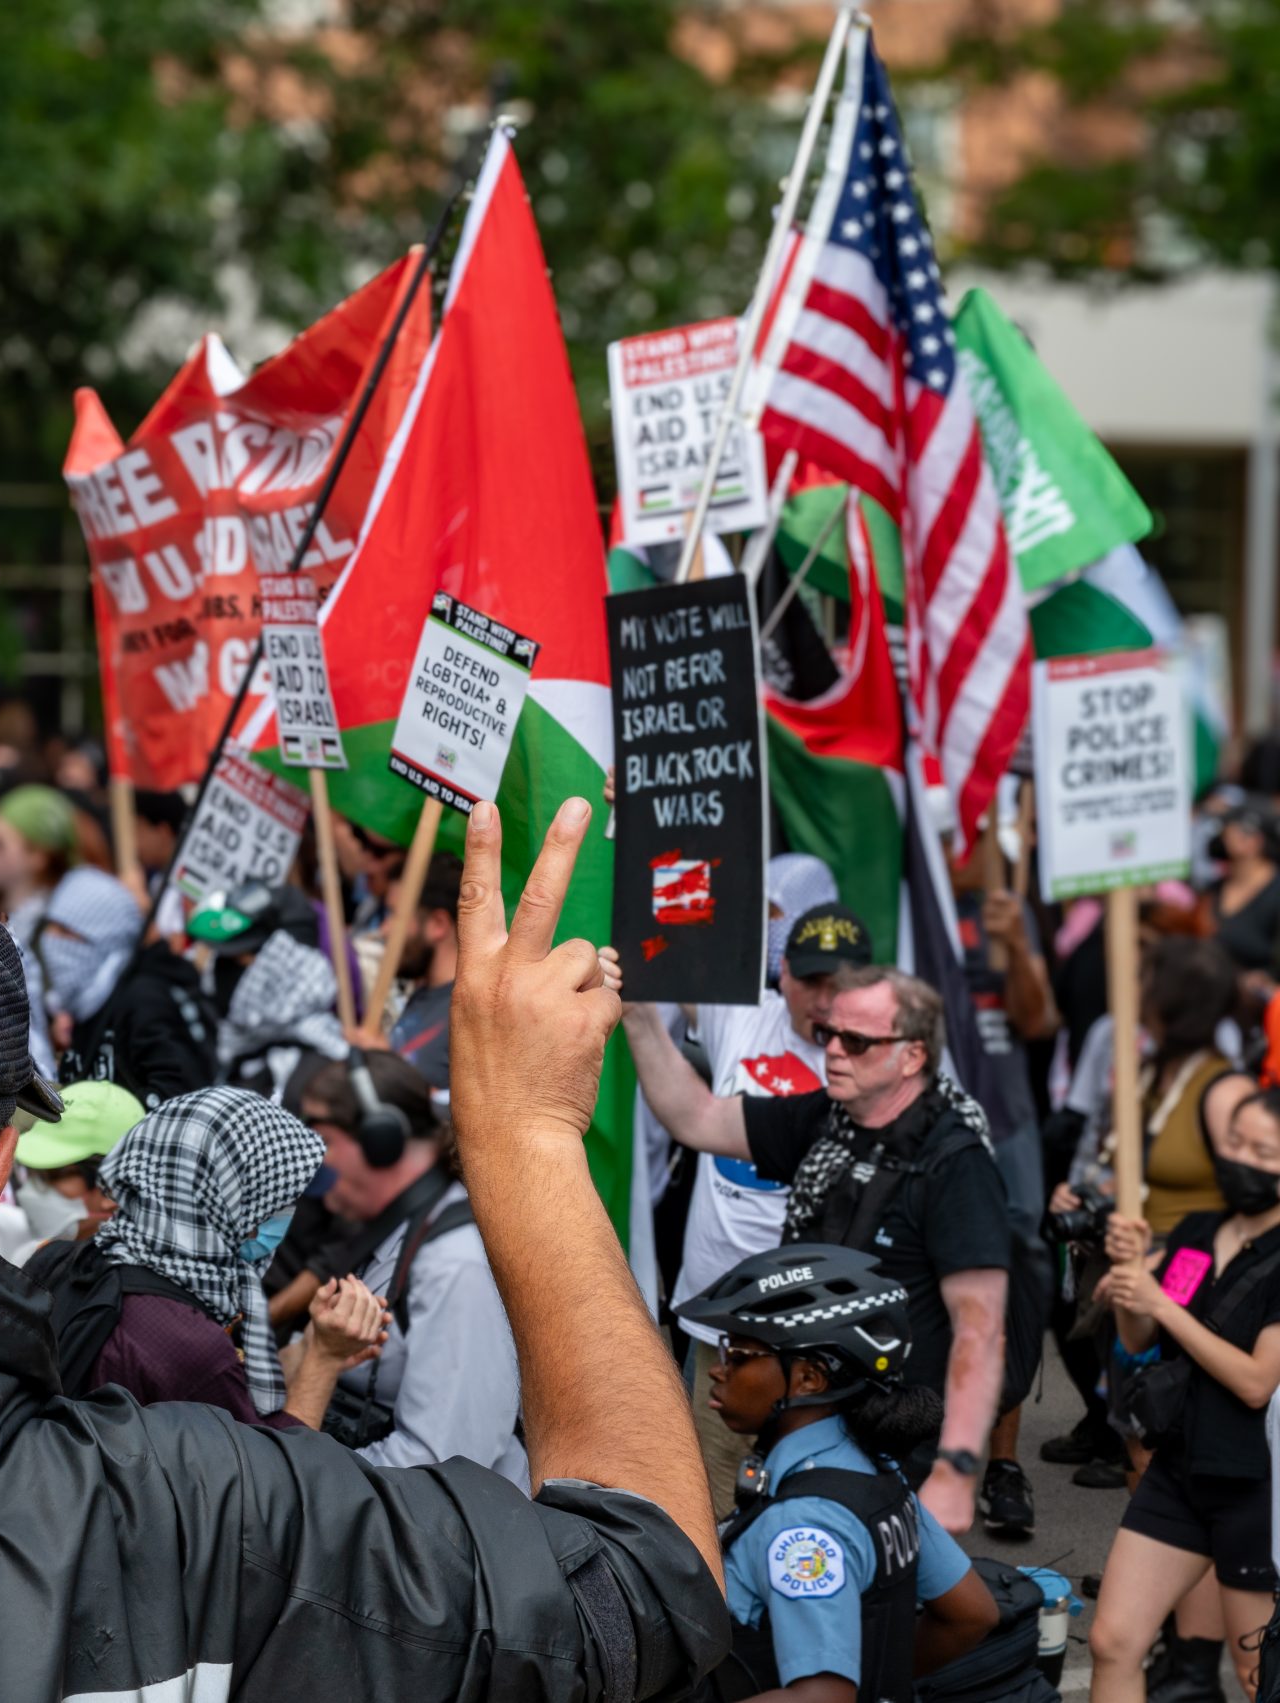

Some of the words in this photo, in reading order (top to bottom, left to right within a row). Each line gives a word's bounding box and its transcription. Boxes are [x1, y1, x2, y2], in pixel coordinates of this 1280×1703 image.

[633, 386, 684, 417] END
[635, 415, 686, 447] AID
[455, 604, 490, 630] STAND
[490, 619, 516, 645] WITH
[621, 615, 646, 651] MY
[651, 605, 704, 644] VOTE
[707, 602, 751, 632] WILL
[270, 635, 299, 660] END
[443, 645, 500, 688] DEFEND
[276, 664, 303, 693] AID
[306, 665, 326, 695] TO
[423, 657, 491, 704] LGBTQIA+
[495, 698, 507, 716] &
[623, 663, 658, 700] NOT
[415, 675, 507, 737] REPRODUCTIVE
[1081, 682, 1154, 719] STOP
[421, 701, 487, 751] RIGHTS!
[1067, 714, 1166, 753] POLICE
[210, 785, 251, 825] END
[423, 776, 440, 794] AID
[440, 787, 454, 803] TO
[653, 789, 725, 828] WARS
[190, 837, 238, 880] ISRA
[199, 813, 242, 852] AID
[250, 843, 281, 881] TO
[758, 1267, 814, 1293] POLICE
[775, 1531, 837, 1562] CHICAGO
[781, 1569, 836, 1593] POLICE
